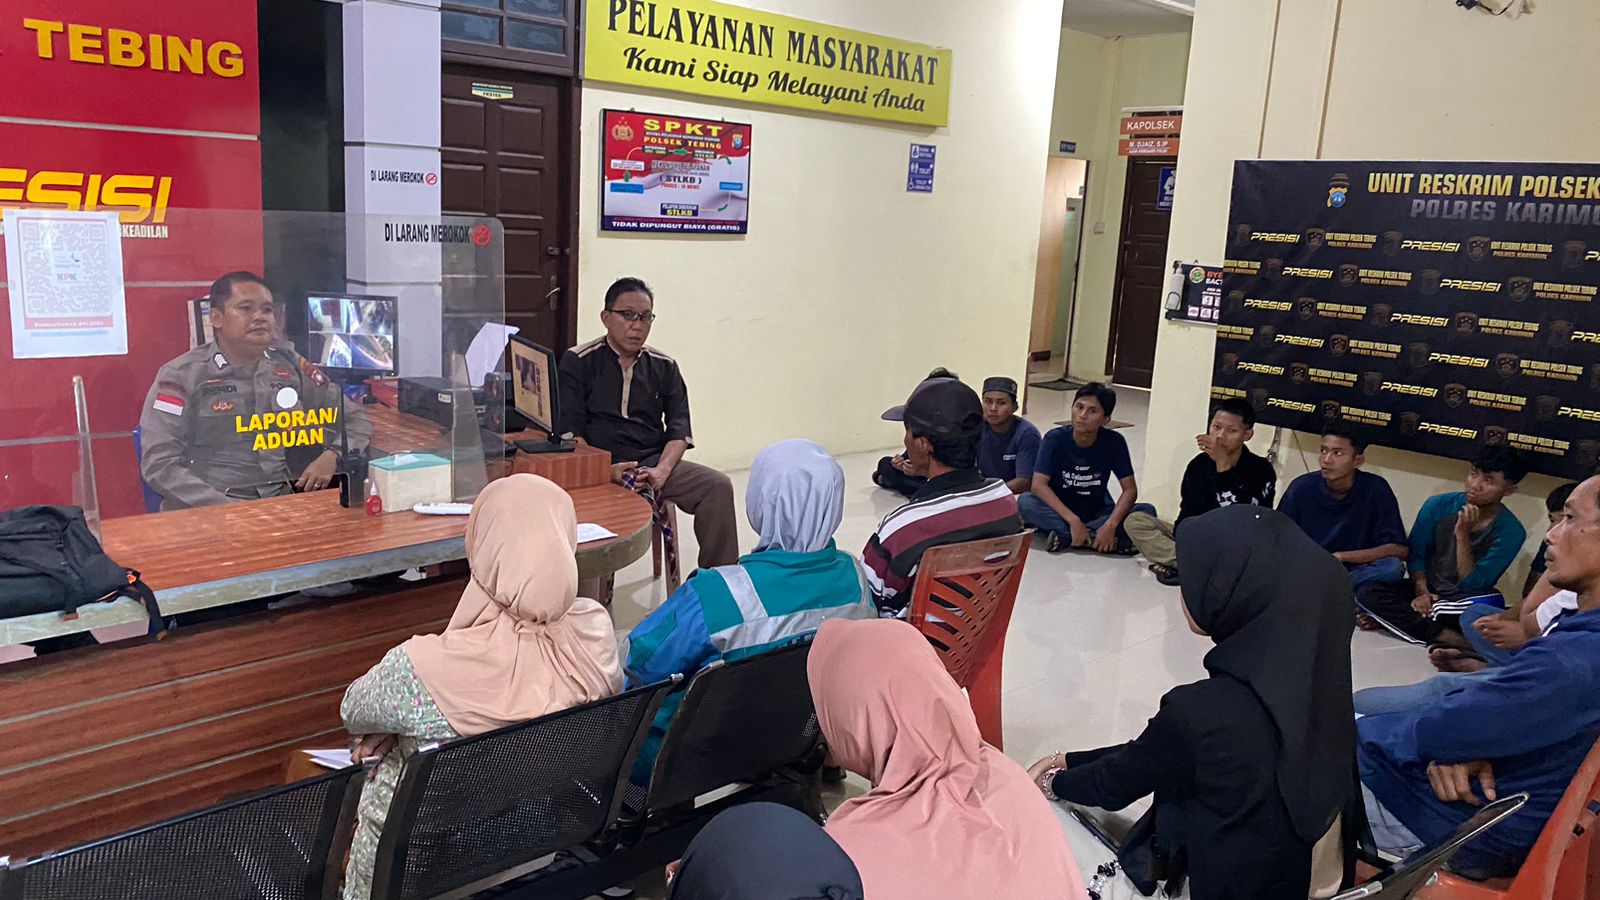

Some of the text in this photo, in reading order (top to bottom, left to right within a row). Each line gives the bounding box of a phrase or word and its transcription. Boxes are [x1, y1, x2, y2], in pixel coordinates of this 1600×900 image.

[24, 18, 244, 78] TEBING
[608, 0, 938, 85] PELAYANAN MASYARAKAT
[624, 47, 925, 112] Kami Siap Melayani Anda
[644, 119, 722, 137] SPKT
[1127, 120, 1175, 130] KAPOLSEK
[644, 136, 722, 149] POLSEK TEBING
[371, 170, 424, 183] DI LARANG MEROKOK
[1368, 173, 1600, 199] UNIT RESKRIM POLSEK
[1410, 199, 1496, 220] POLRES
[385, 223, 470, 243] DI LARANG MEROKOK
[1251, 233, 1300, 243] PRESISI
[1401, 240, 1460, 252] PRESISI
[1282, 267, 1333, 278] PRESISI
[1440, 279, 1501, 292] PRESISI
[1244, 299, 1292, 311] PRESISI
[1390, 313, 1449, 327] PRESISI
[1274, 334, 1324, 348] PRESISI
[1428, 352, 1490, 368] PRESISI
[1237, 362, 1284, 375] PRESISI
[1380, 382, 1438, 398] PRESISI
[1267, 398, 1316, 412] PRESISI
[235, 407, 339, 432] LAPORAN/
[1418, 422, 1478, 439] PRESISI
[253, 428, 324, 451] ADUAN
